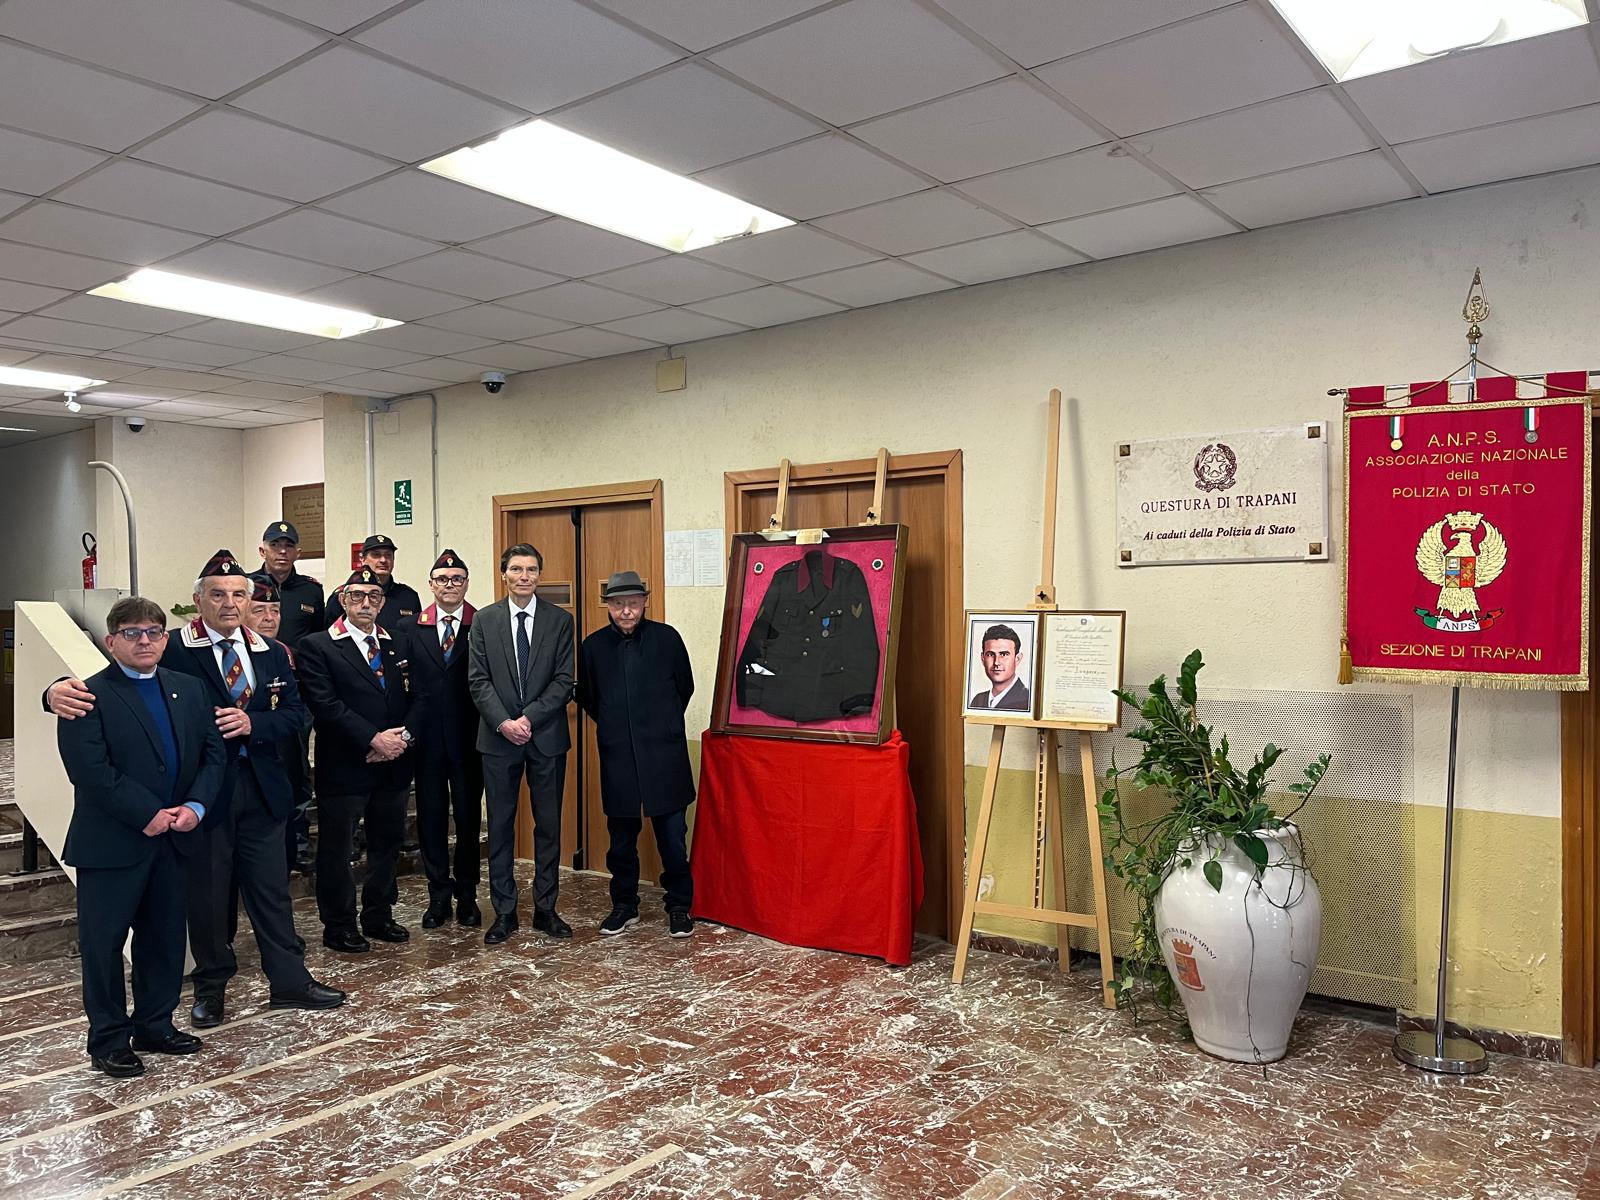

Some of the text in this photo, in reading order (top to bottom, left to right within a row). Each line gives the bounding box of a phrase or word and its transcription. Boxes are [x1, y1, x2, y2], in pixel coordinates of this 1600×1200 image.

[1365, 447, 1568, 467] ASSOCIAZIONE NAZIONALE
[1446, 469, 1480, 481] della
[1392, 482, 1536, 498] POLIZIA DI STATO
[1140, 492, 1297, 514] QUESTURA DI TRAPANI
[1143, 524, 1296, 541] Ai caduti della Polizia di Stato
[1442, 621, 1476, 631] ANPS
[1380, 643, 1542, 662] SEZIONE DI TRAPANI
[1188, 932, 1217, 959] TRAPANI
